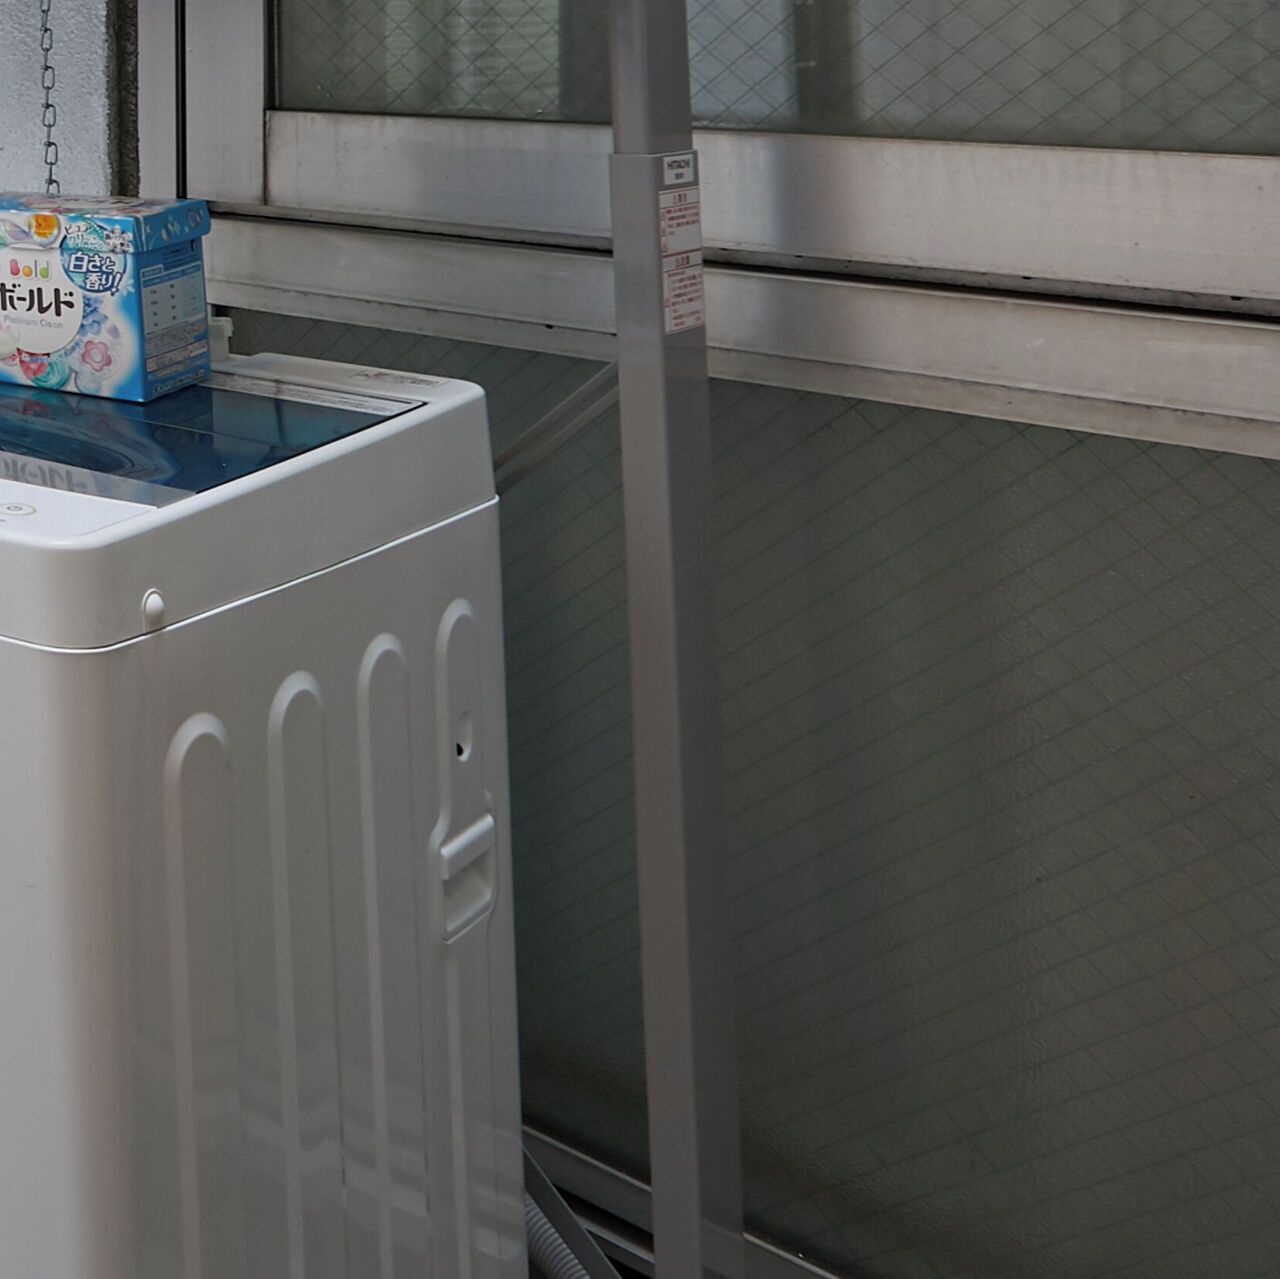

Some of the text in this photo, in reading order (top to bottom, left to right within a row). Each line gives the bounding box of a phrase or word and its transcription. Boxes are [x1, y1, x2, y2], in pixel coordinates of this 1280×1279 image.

[667, 159, 690, 170] HITACHI
[9, 258, 50, 279] bold
[68, 250, 116, 273] 白さと
[85, 271, 122, 294] 香り!
